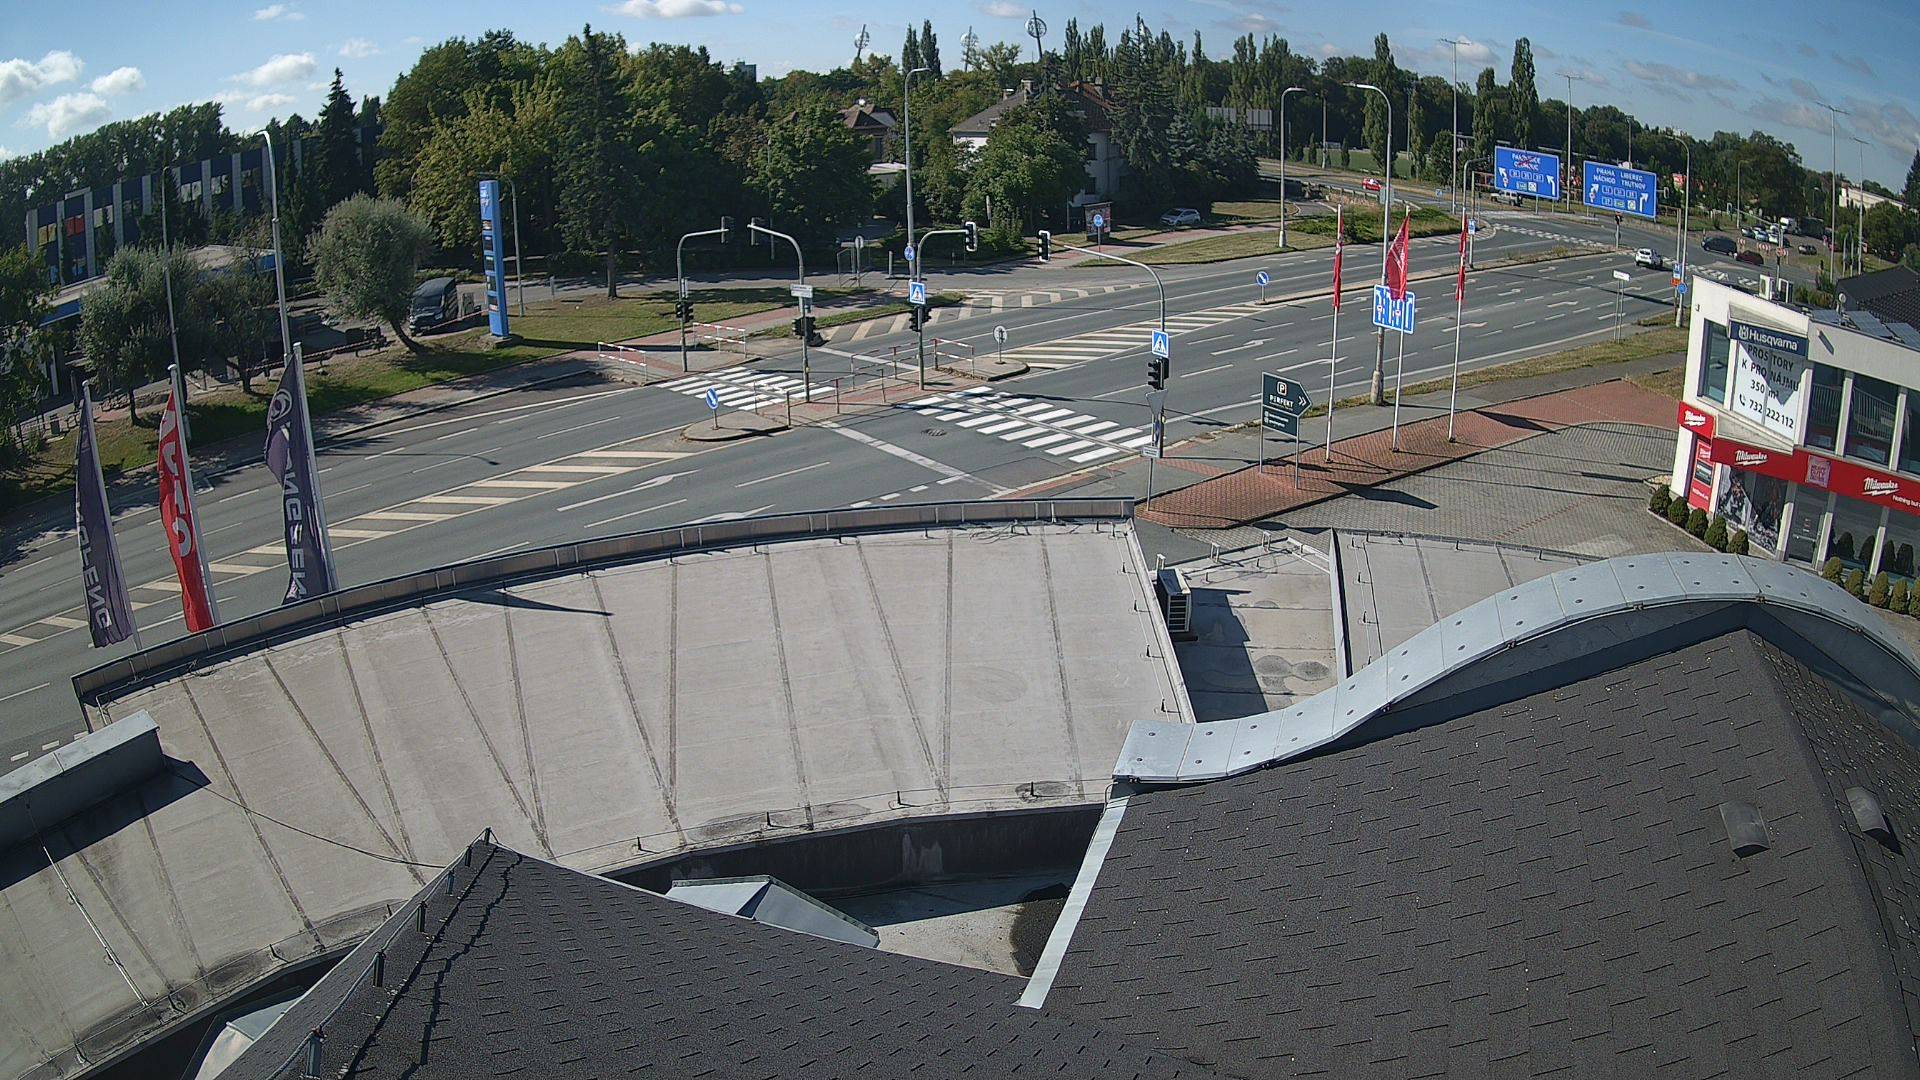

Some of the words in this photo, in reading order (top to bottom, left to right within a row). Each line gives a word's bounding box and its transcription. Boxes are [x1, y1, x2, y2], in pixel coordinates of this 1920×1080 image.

[1749, 330, 1798, 351] Husqvarna
[1741, 359, 1747, 369] K
[1750, 379, 1765, 394] 350
[1269, 394, 1294, 408] PERFEKT
[1749, 399, 1763, 414] 732
